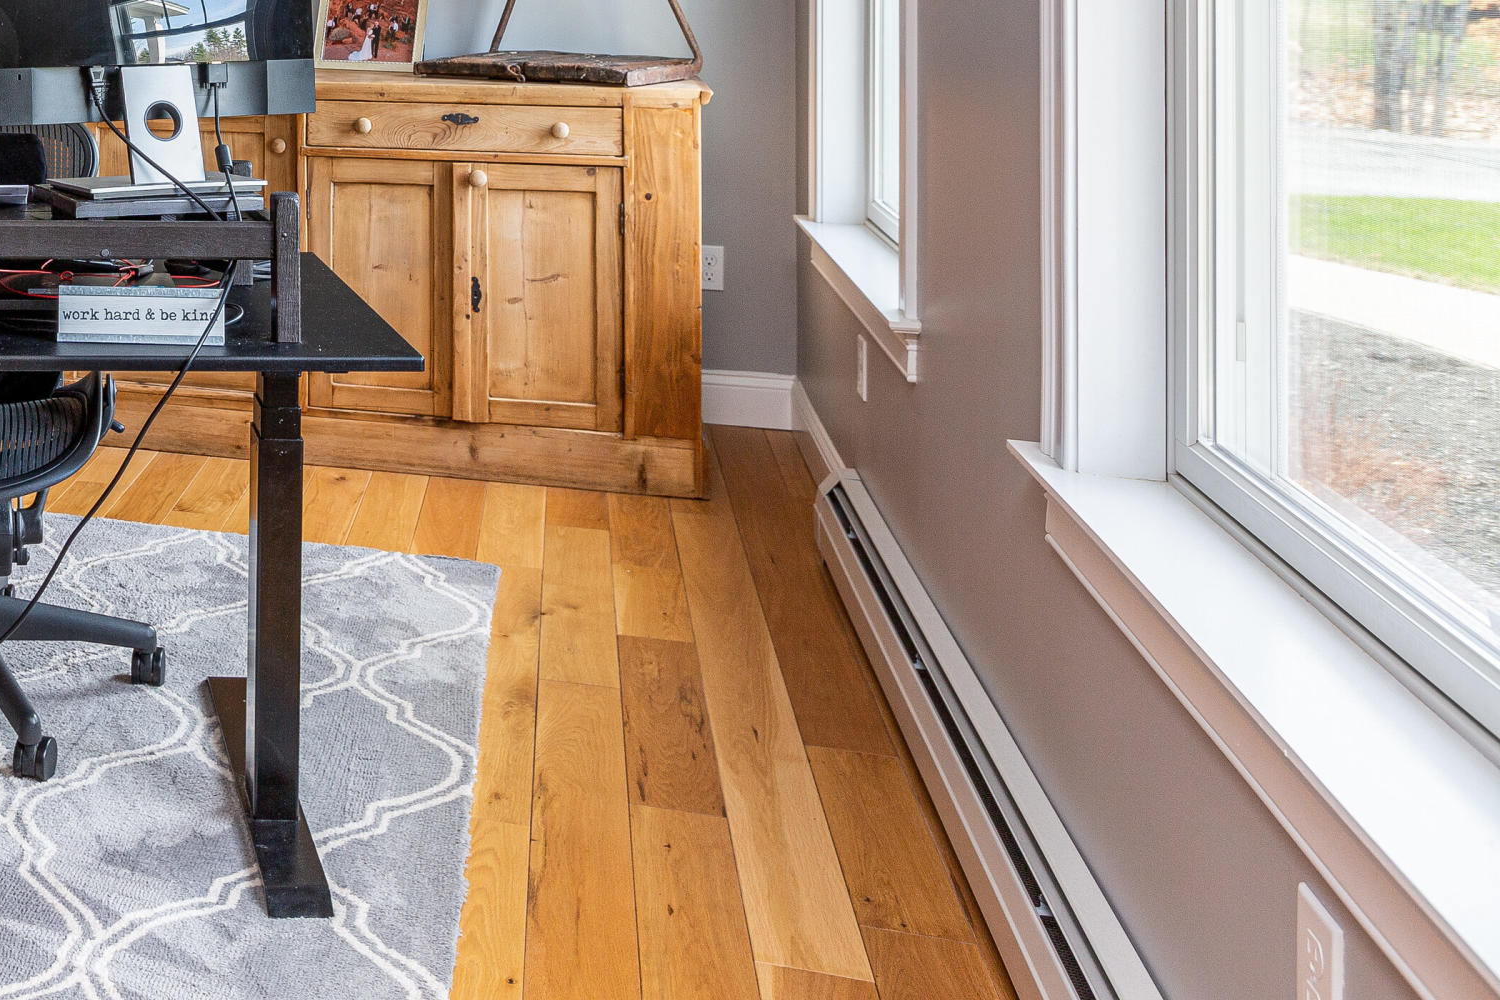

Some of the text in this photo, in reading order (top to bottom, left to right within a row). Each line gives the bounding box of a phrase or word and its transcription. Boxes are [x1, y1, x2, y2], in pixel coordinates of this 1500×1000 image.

[62, 307, 100, 321] work
[104, 308, 140, 321] hard
[145, 308, 156, 320] &
[160, 309, 177, 320] be
